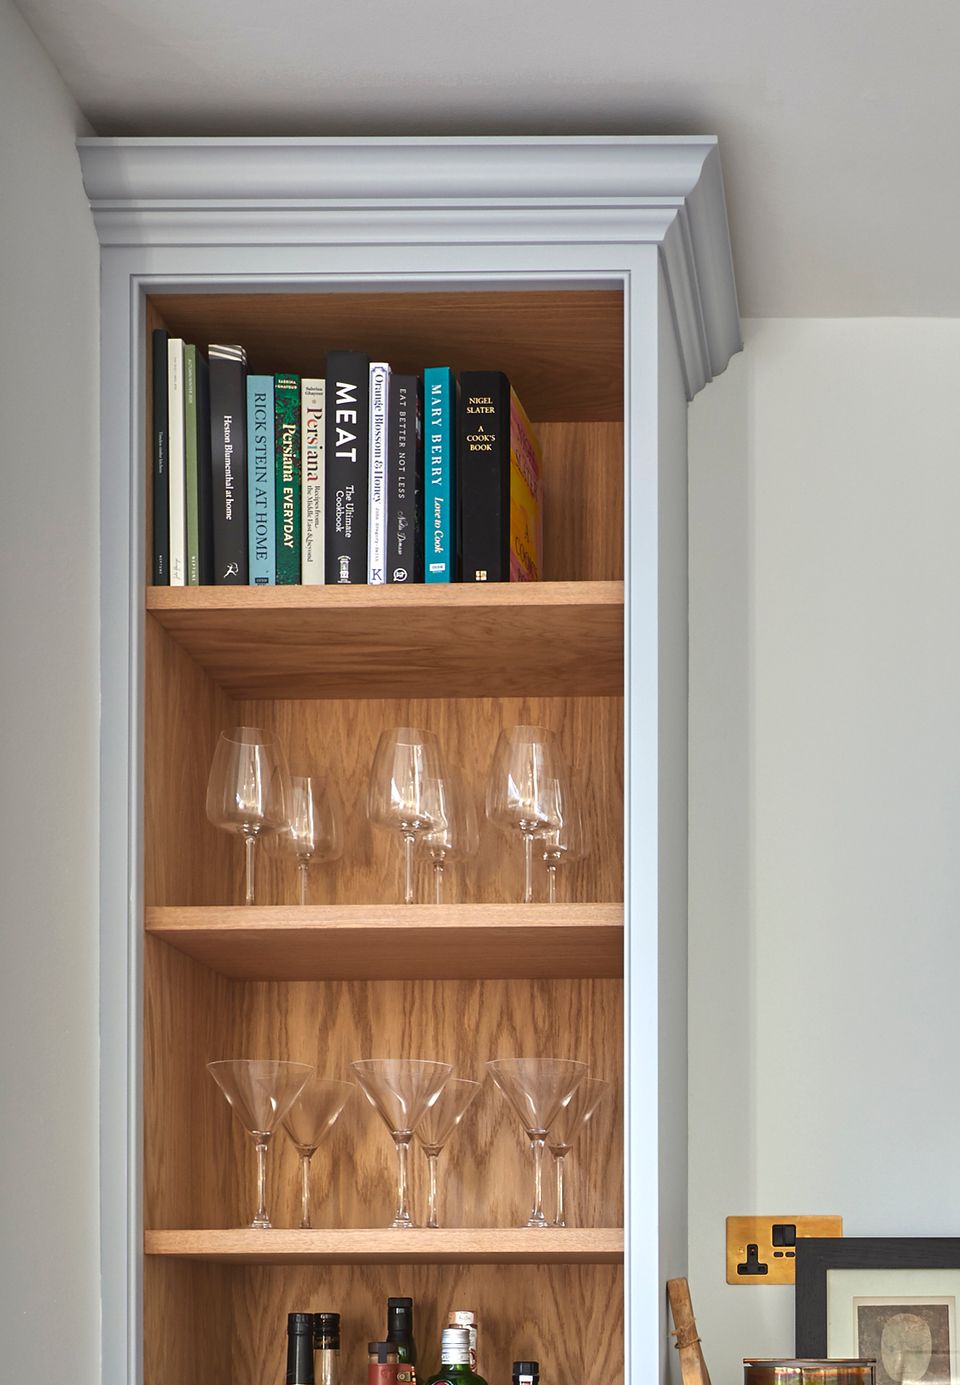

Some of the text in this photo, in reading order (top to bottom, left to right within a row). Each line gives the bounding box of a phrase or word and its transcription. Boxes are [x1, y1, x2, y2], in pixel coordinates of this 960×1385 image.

[371, 374, 384, 412] Orange
[466, 406, 495, 414] SLATER
[469, 397, 493, 405] NIGEL
[335, 382, 357, 462] MEAT
[373, 413, 384, 458] Blossom
[432, 384, 442, 486] MARY BERRY
[466, 434, 496, 442] COOK'S
[306, 407, 323, 481] Persiana
[398, 388, 407, 499] EAT BETTER NOT LESS
[223, 415, 234, 520] Heston Blumenthal at home
[254, 393, 268, 561] RICK STEIN AT HOME
[282, 423, 296, 548] Persiana EVERYDAY
[372, 469, 384, 503] Honey
[313, 485, 321, 509] Recipes
[335, 490, 345, 532] Cookbook
[344, 485, 354, 538] The Ultimate
[434, 497, 444, 519] Love
[434, 519, 442, 528] to
[434, 530, 444, 553] Cook
[305, 540, 314, 562] beyond
